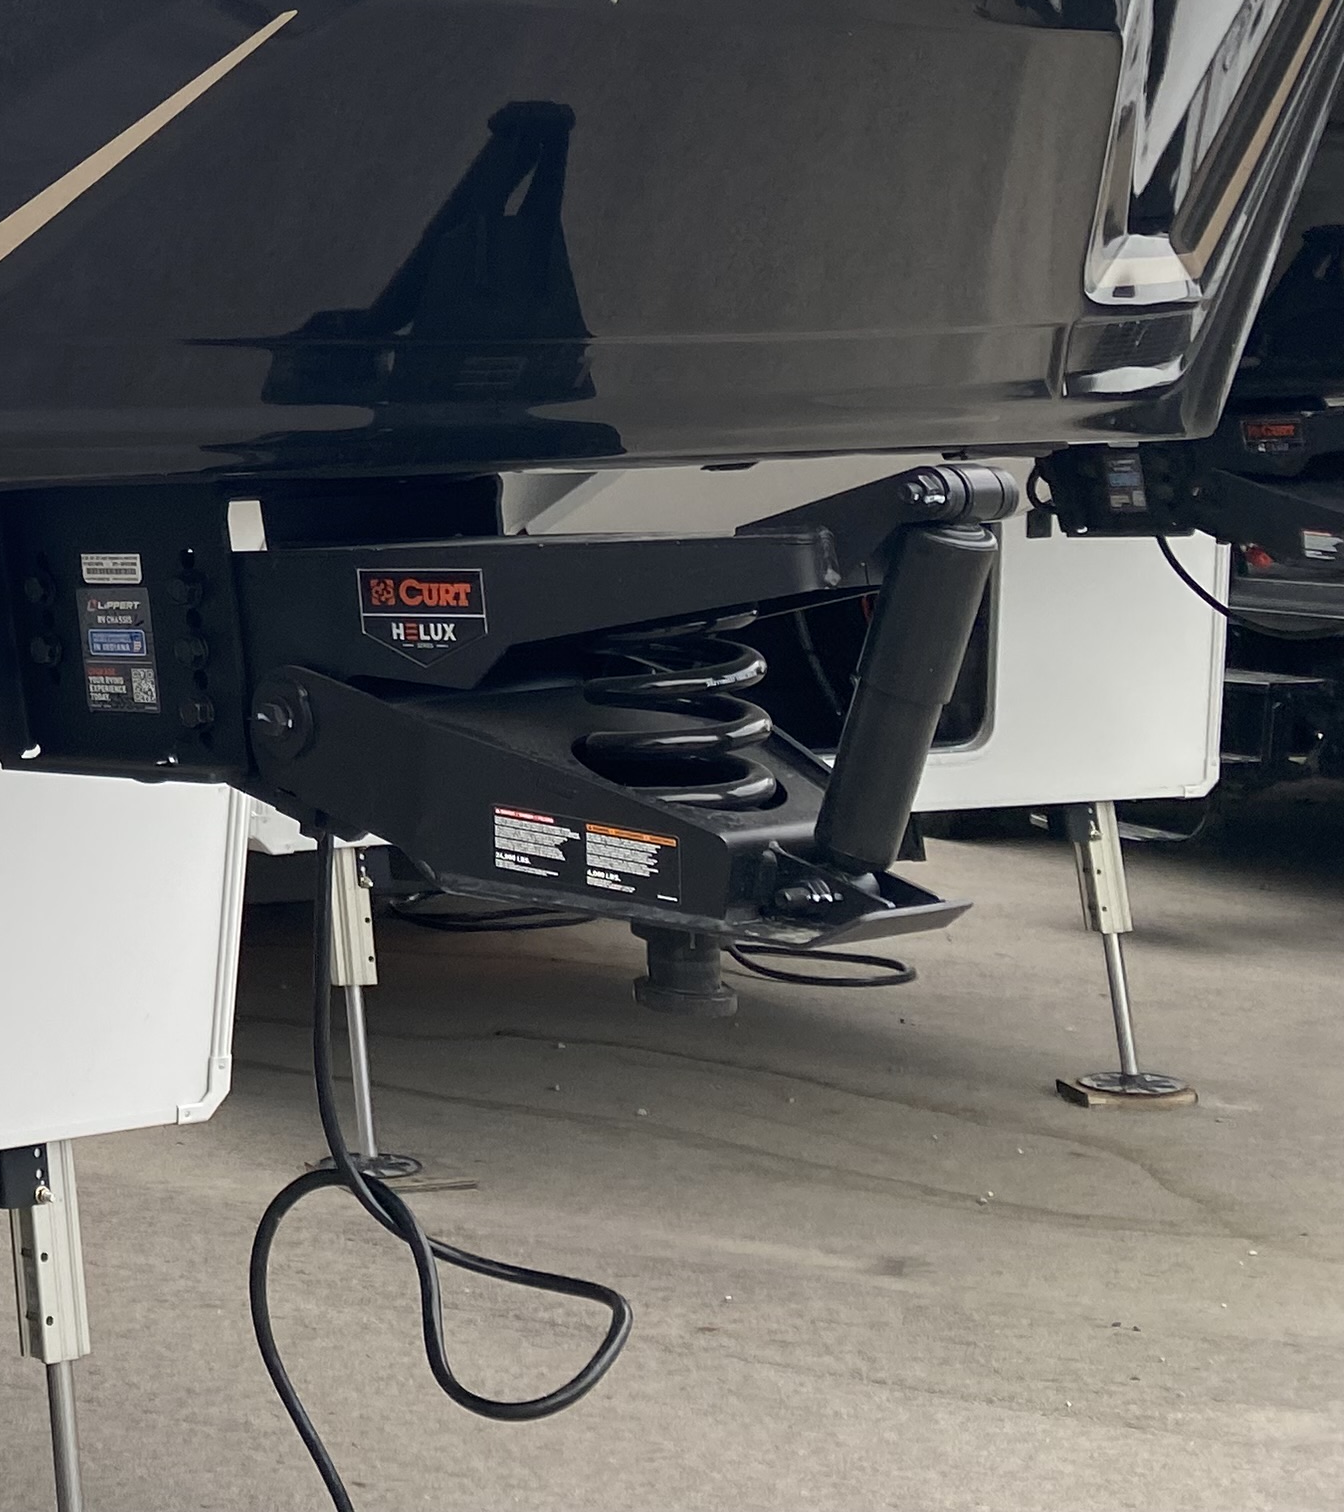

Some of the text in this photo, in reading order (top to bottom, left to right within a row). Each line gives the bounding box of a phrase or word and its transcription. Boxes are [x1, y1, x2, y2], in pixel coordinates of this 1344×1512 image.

[399, 578, 471, 607] CURT
[106, 615, 133, 625] CHASSIS
[391, 622, 457, 642] HELUX
